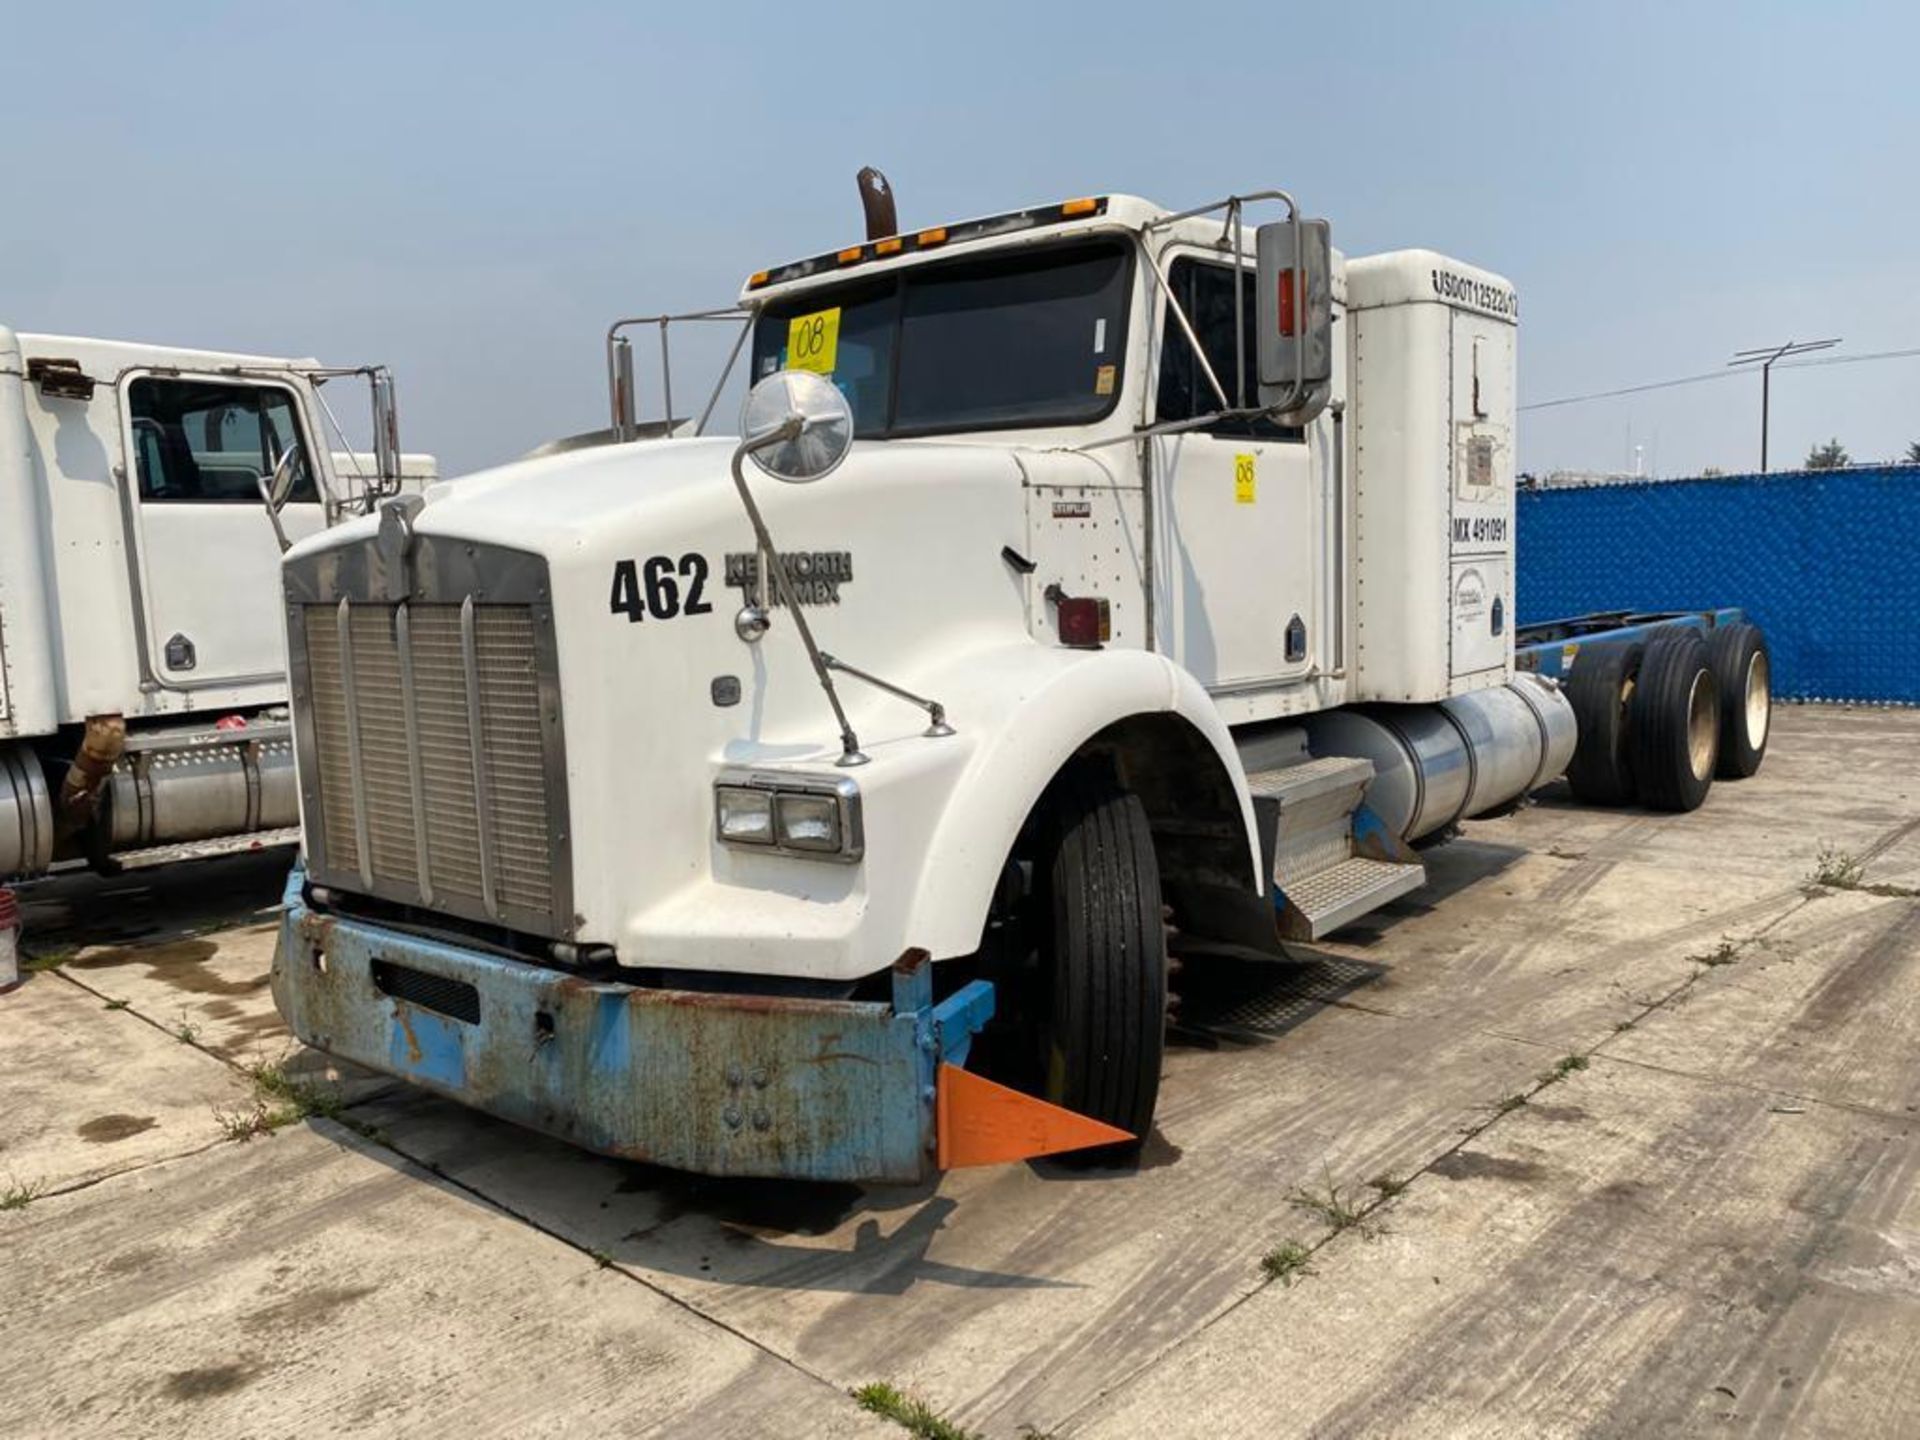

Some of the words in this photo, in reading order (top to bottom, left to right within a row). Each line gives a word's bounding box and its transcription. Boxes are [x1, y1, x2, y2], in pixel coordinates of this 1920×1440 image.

[797, 316, 824, 359] 08
[1236, 460, 1254, 483] 08
[1453, 517, 1470, 542] MX
[1472, 517, 1506, 541] 491091
[724, 552, 852, 580] KEWORTH
[610, 552, 713, 623] 462
